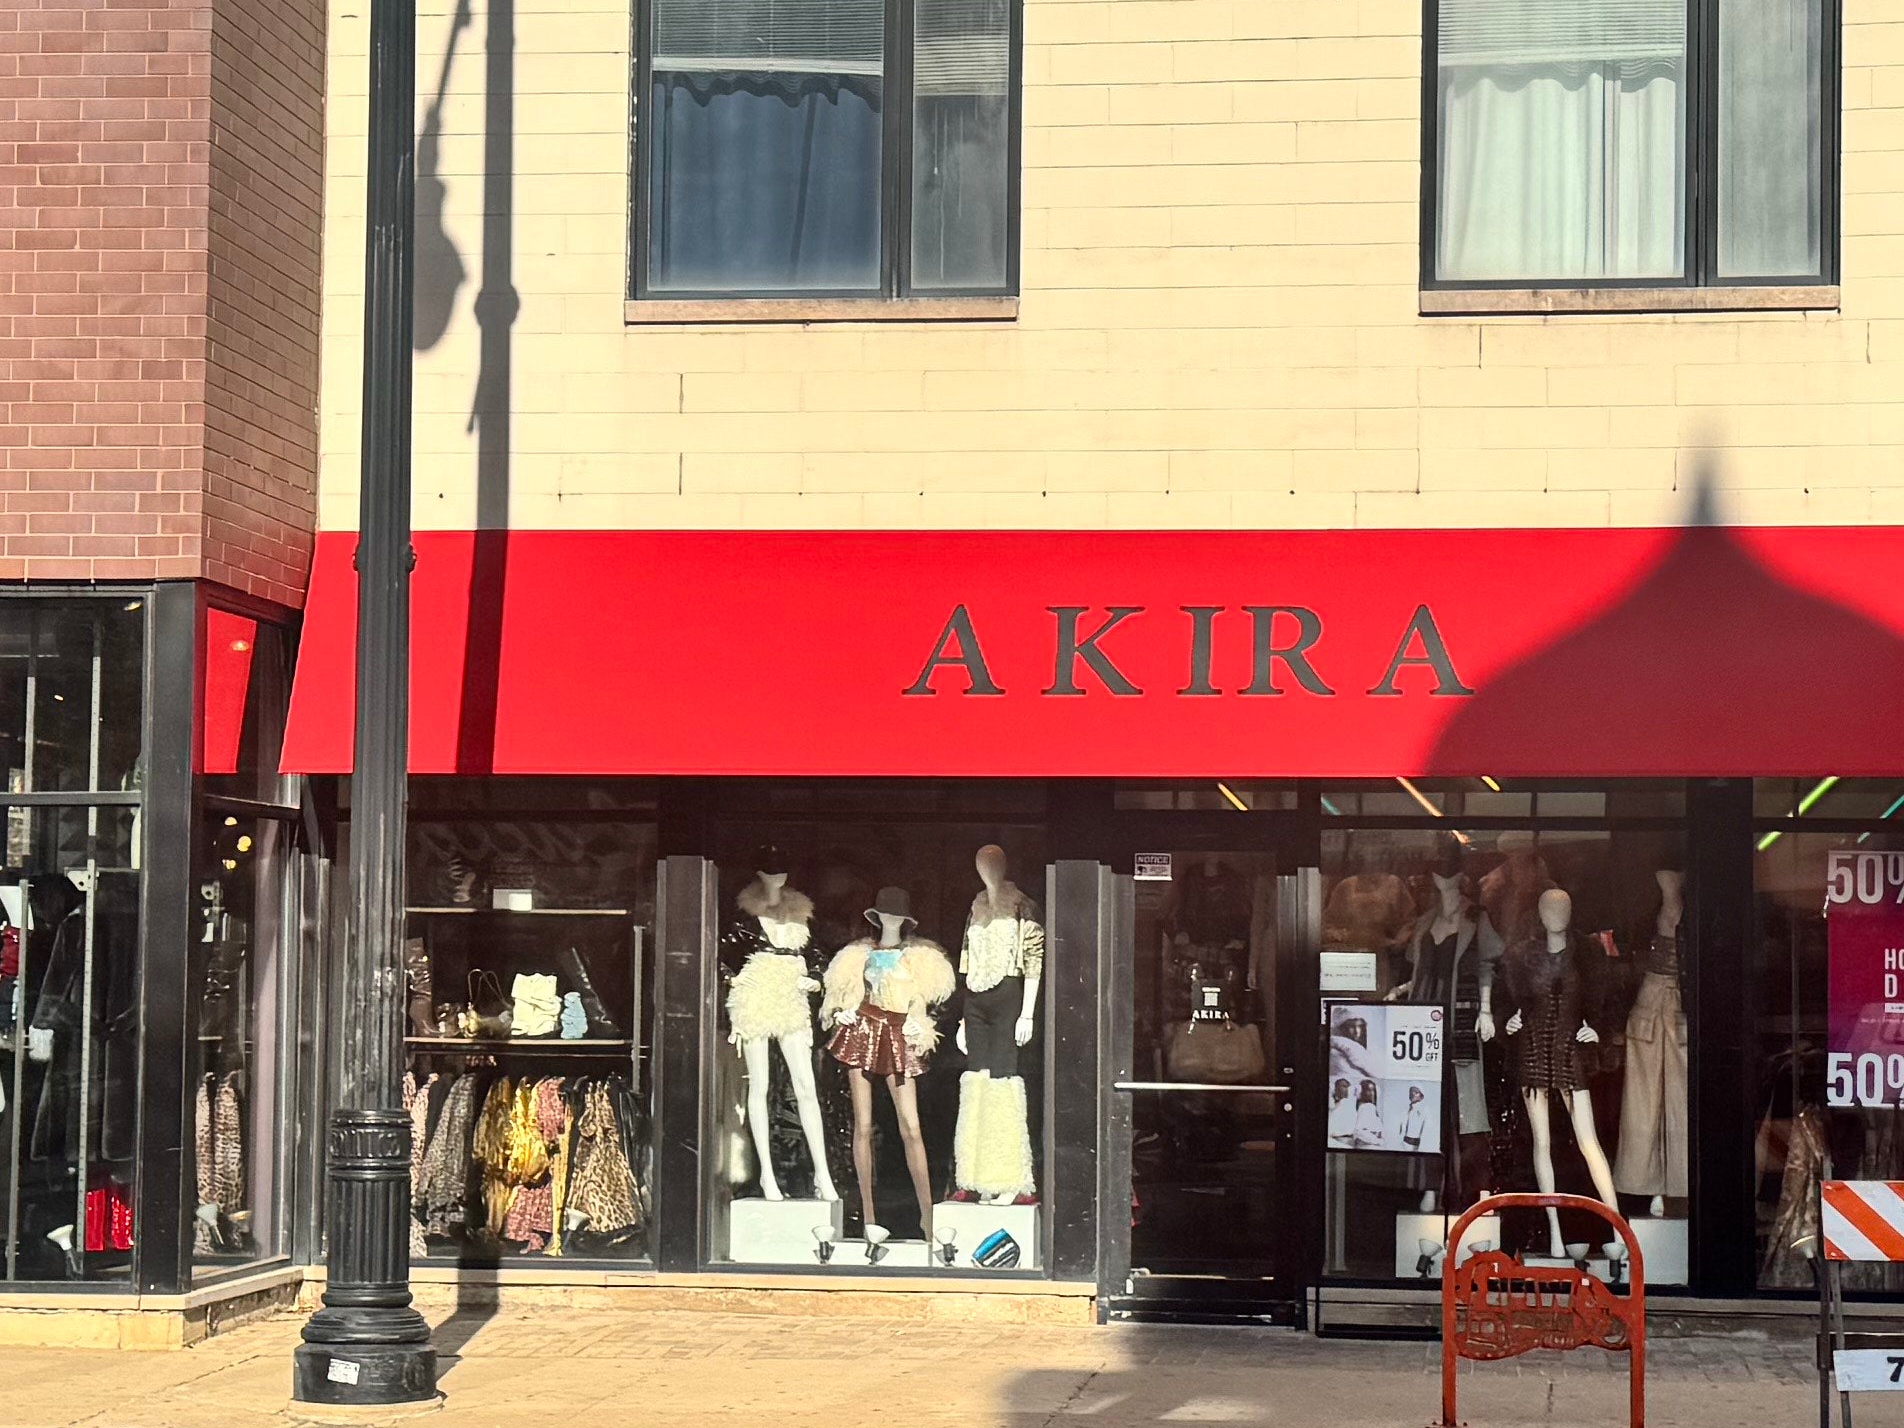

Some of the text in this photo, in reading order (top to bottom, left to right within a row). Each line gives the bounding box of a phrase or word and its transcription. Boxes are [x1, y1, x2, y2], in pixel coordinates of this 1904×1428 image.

[900, 603, 1475, 697] AKIRA
[1192, 1009, 1230, 1019] AKIRA
[1392, 1030, 1440, 1061] 50%
